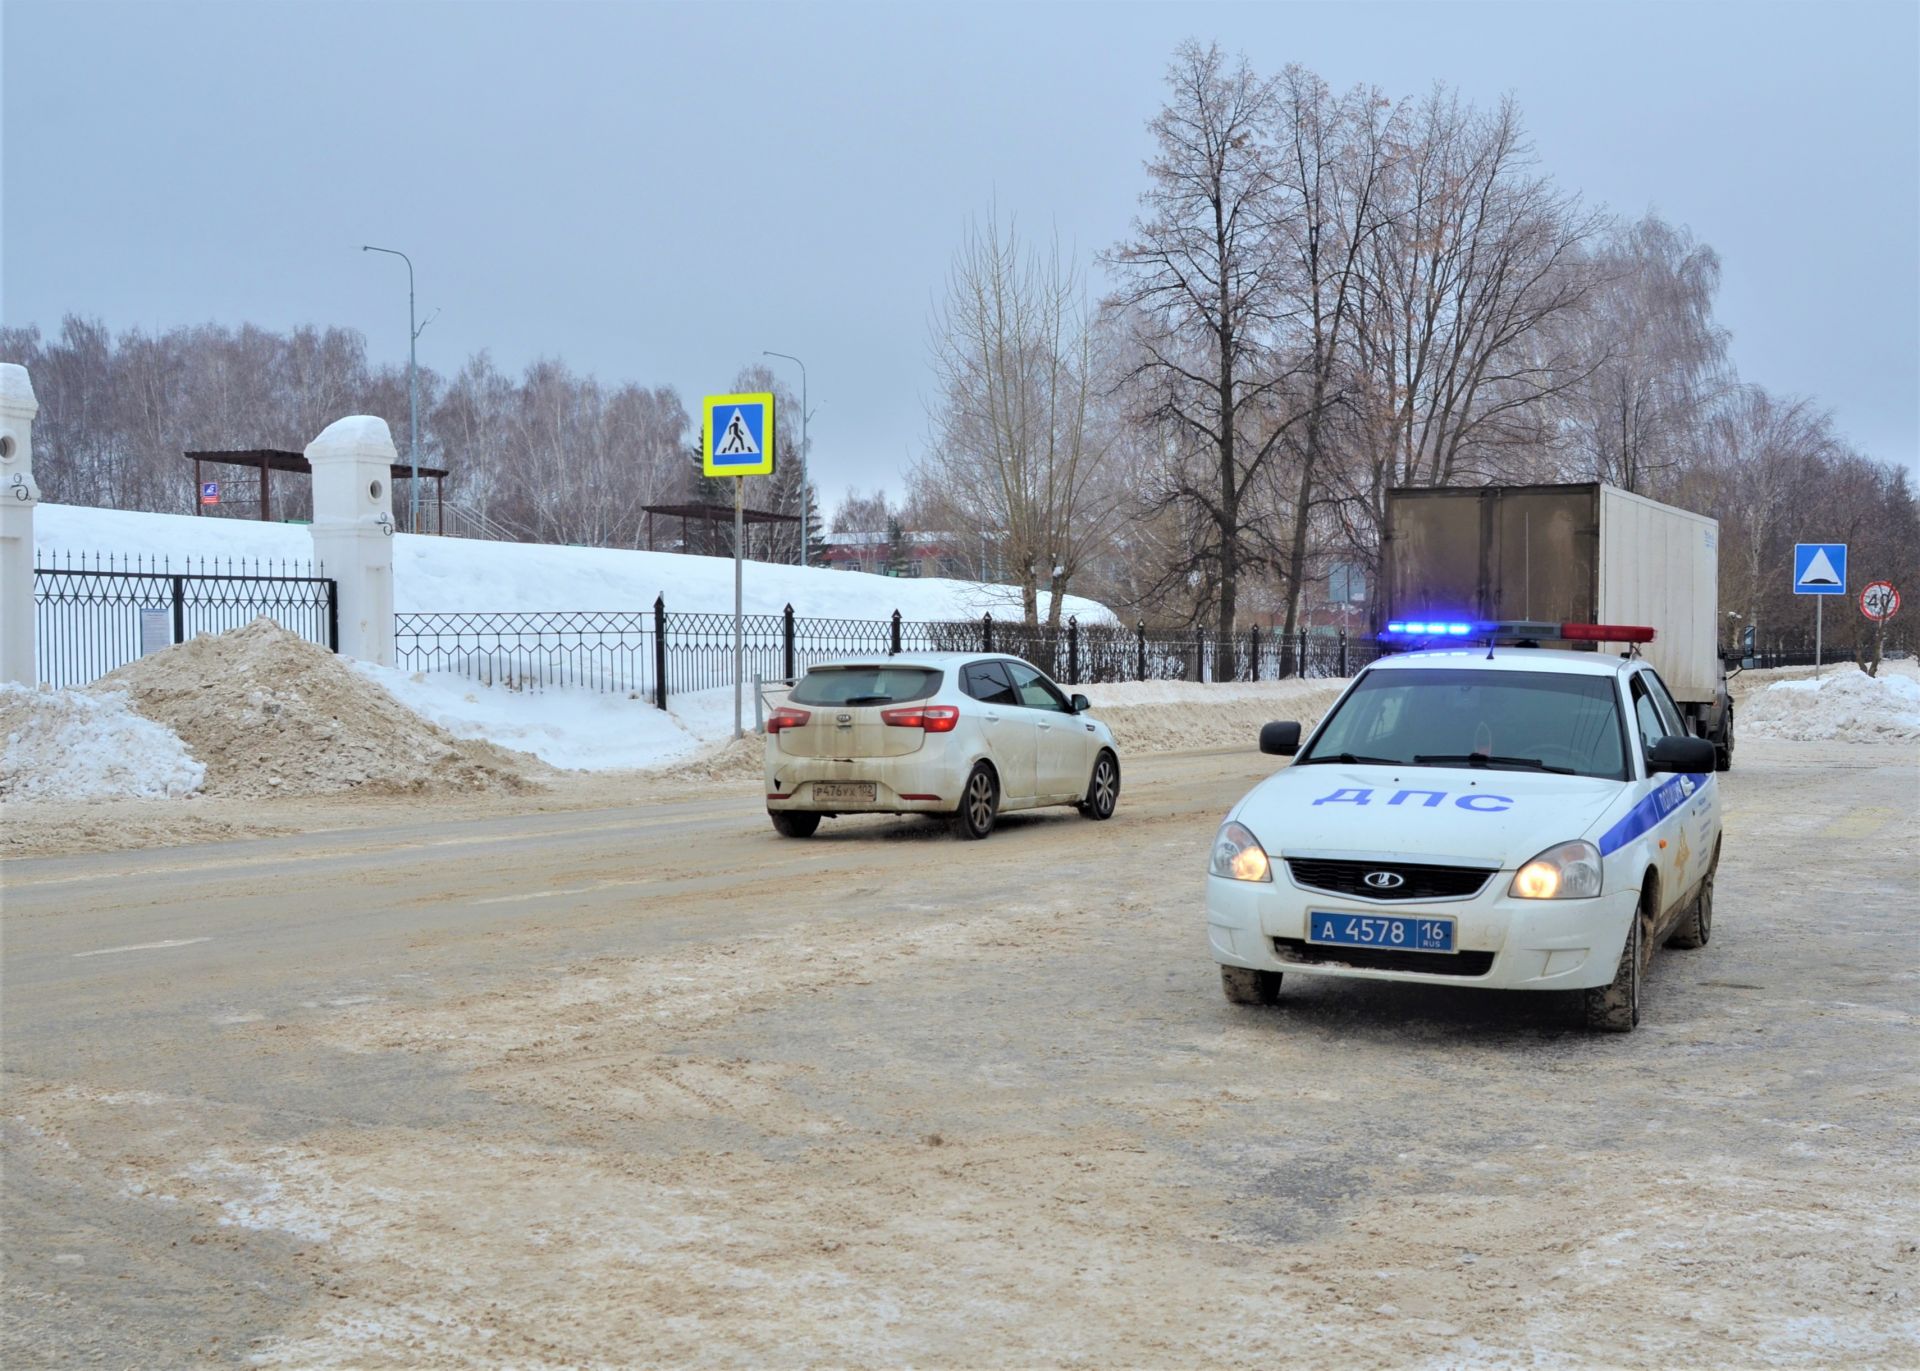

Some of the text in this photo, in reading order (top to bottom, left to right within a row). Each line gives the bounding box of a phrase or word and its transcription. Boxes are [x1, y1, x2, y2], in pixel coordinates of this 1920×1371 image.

[1867, 594, 1889, 609] 40
[1312, 788, 1515, 812] ДПС
[1345, 919, 1404, 944] 4578
[1421, 922, 1444, 940] 16
[1422, 940, 1441, 948] RUS
